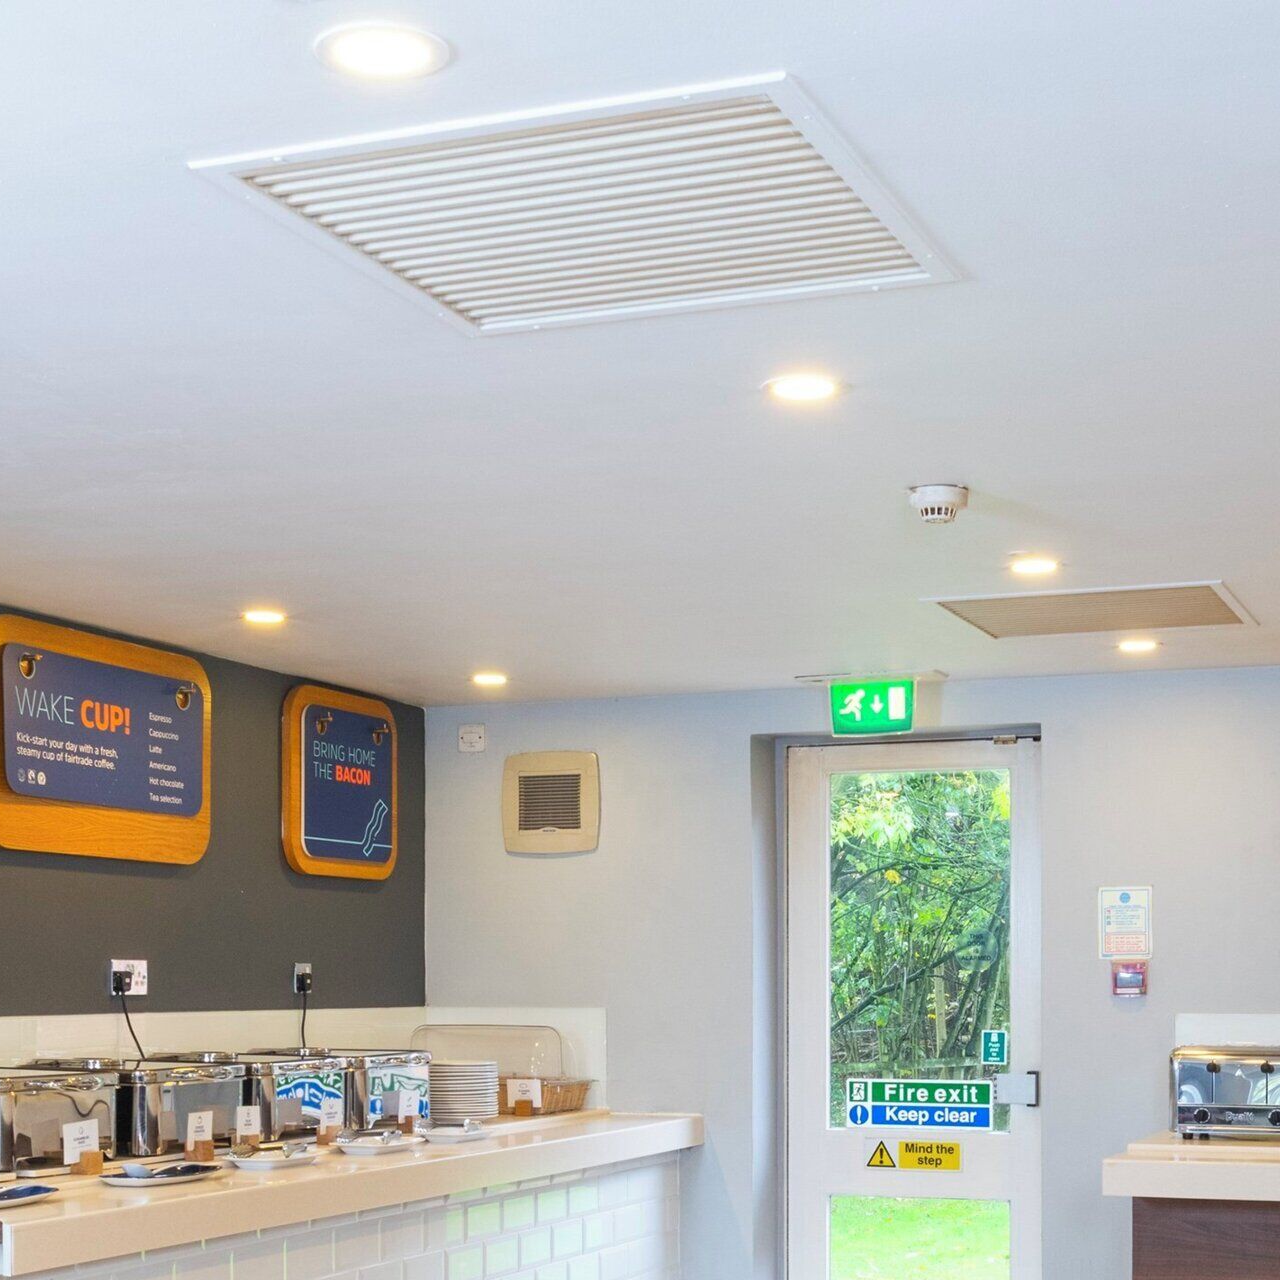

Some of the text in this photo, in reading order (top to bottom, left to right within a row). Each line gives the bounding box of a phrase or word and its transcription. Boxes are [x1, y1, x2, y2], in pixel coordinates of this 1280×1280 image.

[15, 685, 131, 735] WAKE CUP!
[149, 712, 172, 724] Espresso
[149, 728, 179, 741] Cappuccino
[16, 732, 48, 747] Kick-start
[49, 739, 64, 749] your
[65, 741, 77, 752] day
[79, 744, 93, 754] with
[100, 746, 118, 759] fresh,
[149, 744, 162, 754] Latte
[16, 746, 116, 770] steamy cup of fairtrade coffee.
[313, 740, 376, 767] BRING HOME
[149, 760, 177, 772] Americano
[313, 761, 371, 786] THE BACON
[149, 777, 184, 789] Hot chocolate
[149, 792, 183, 804] Tea selection
[884, 1084, 978, 1103] Fire exit
[885, 1107, 978, 1125] Keep clear
[1225, 1111, 1255, 1122] Dualit
[905, 1143, 954, 1155] Mind the
[917, 1156, 942, 1168] step
